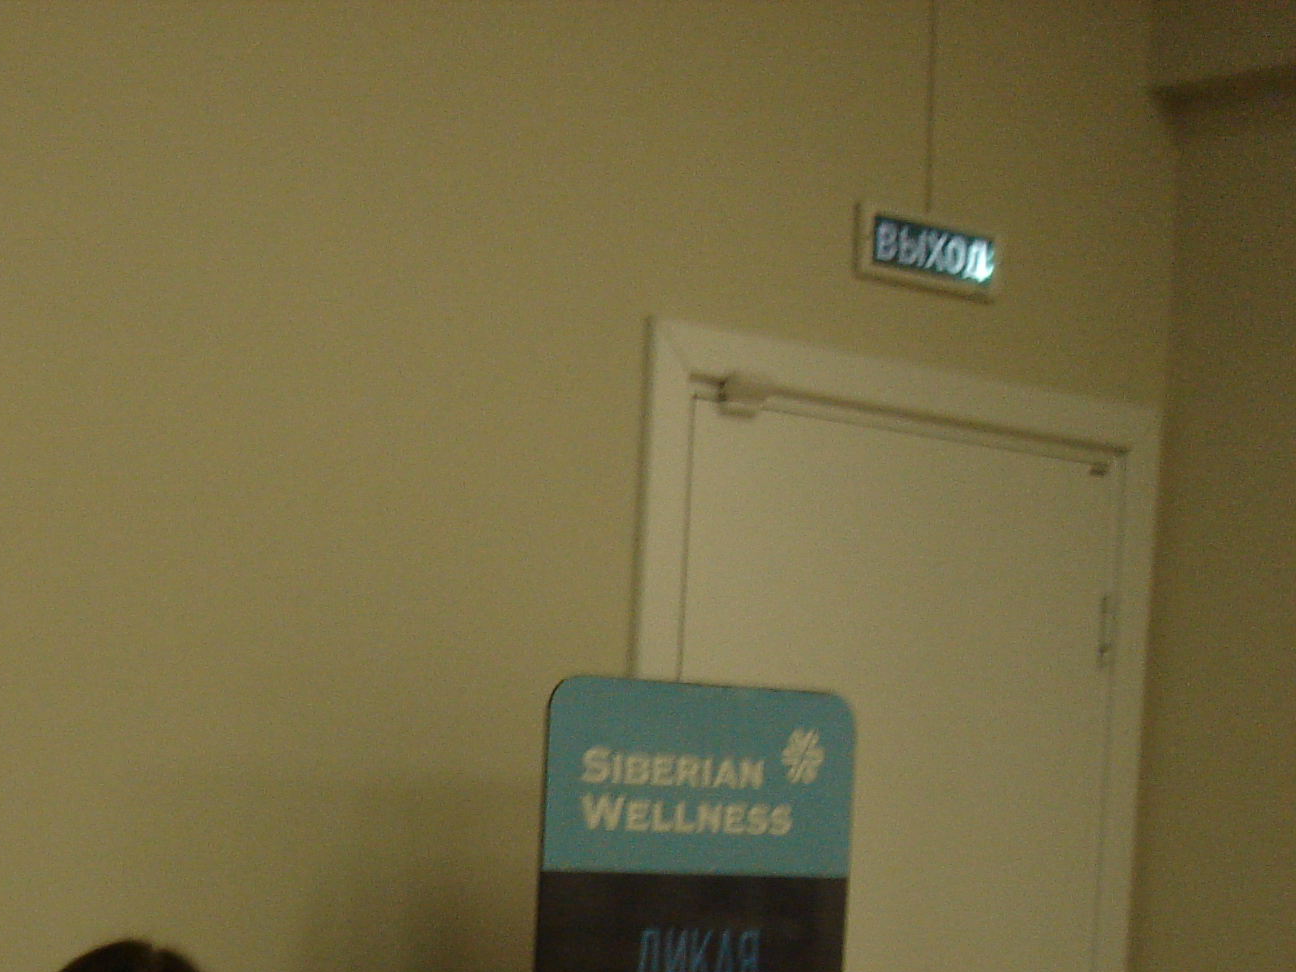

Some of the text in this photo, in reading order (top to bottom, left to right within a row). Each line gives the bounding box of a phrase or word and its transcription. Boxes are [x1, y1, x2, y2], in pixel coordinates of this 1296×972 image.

[876, 220, 995, 283] ВЫХОД
[581, 745, 764, 789] SIBERIAN
[581, 793, 793, 835] WELLNESS
